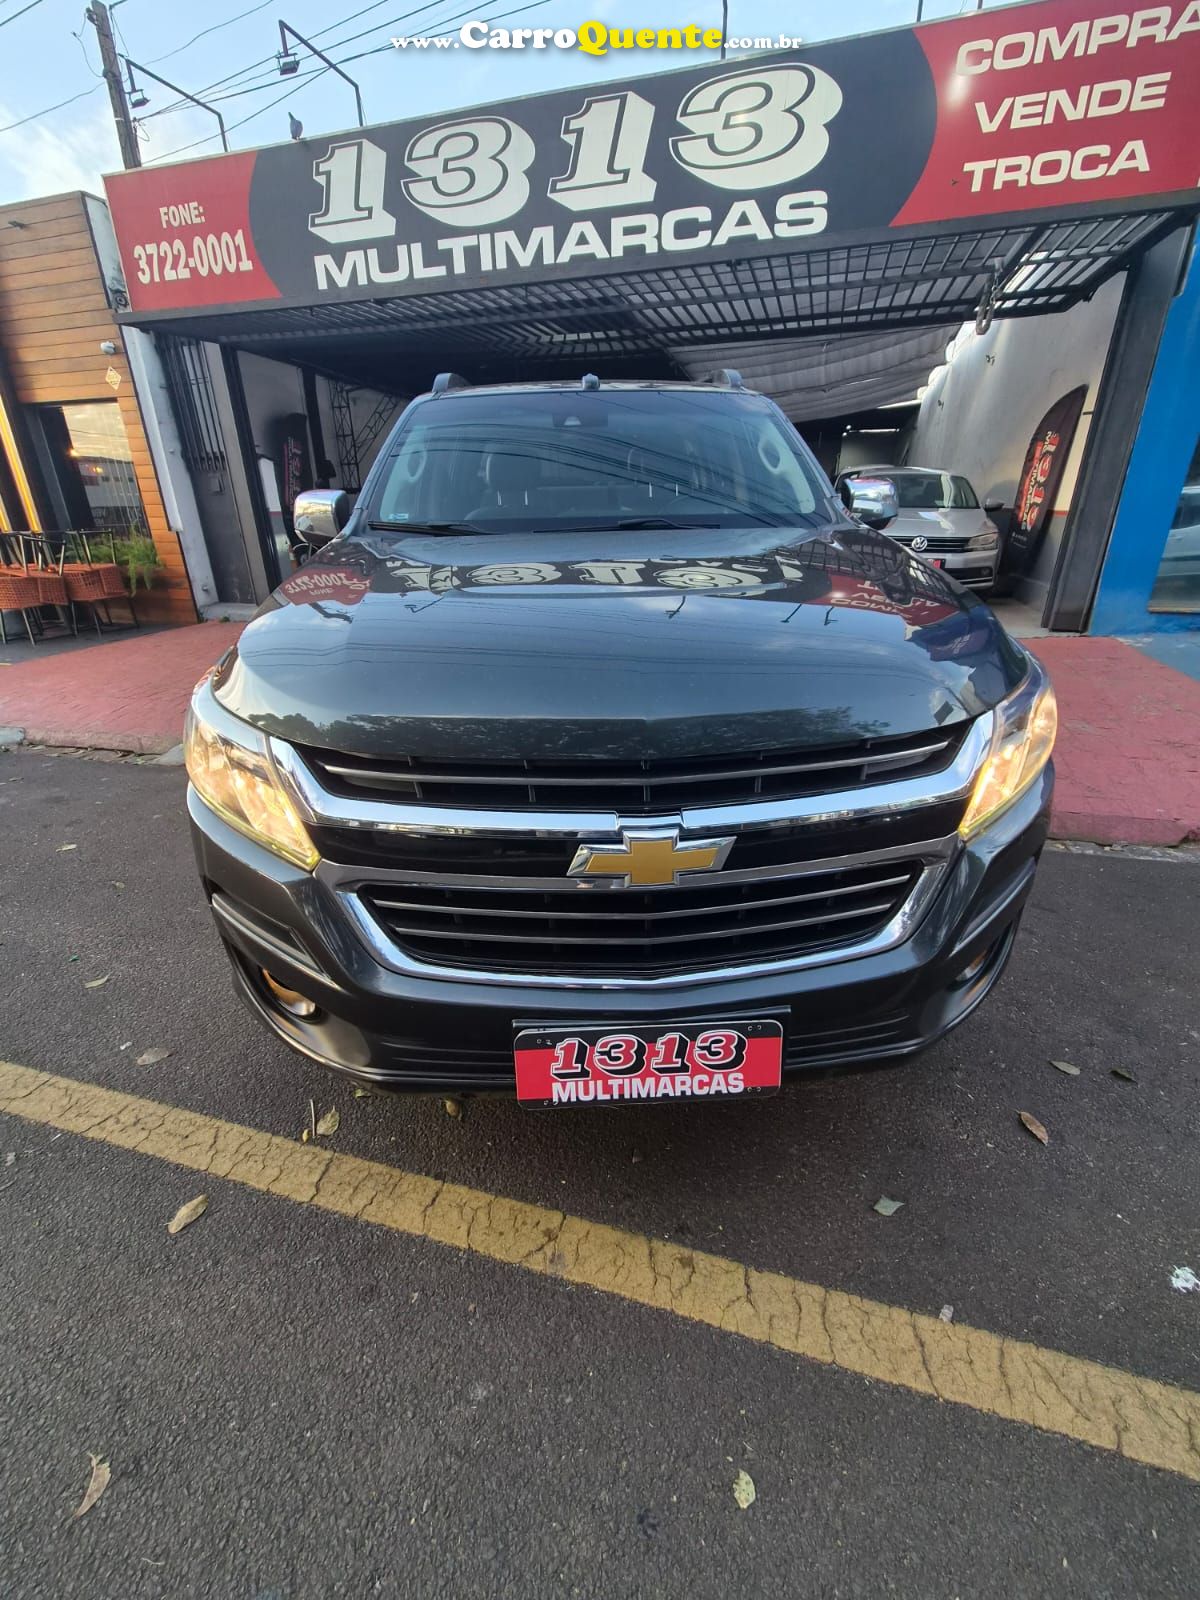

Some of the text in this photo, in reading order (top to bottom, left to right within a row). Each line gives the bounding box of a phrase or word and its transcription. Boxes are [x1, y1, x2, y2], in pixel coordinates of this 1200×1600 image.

[956, 0, 1200, 77] COMPRA
[974, 72, 1172, 134] VENDE
[308, 62, 844, 243] 1313
[963, 140, 1150, 192] TROCA
[159, 201, 206, 228] FONE:
[314, 190, 829, 291] MULTIMARCAS
[133, 229, 254, 285] 3722-0001
[550, 1029, 748, 1082] 1313
[551, 1072, 745, 1104] MULTIMARCAS
